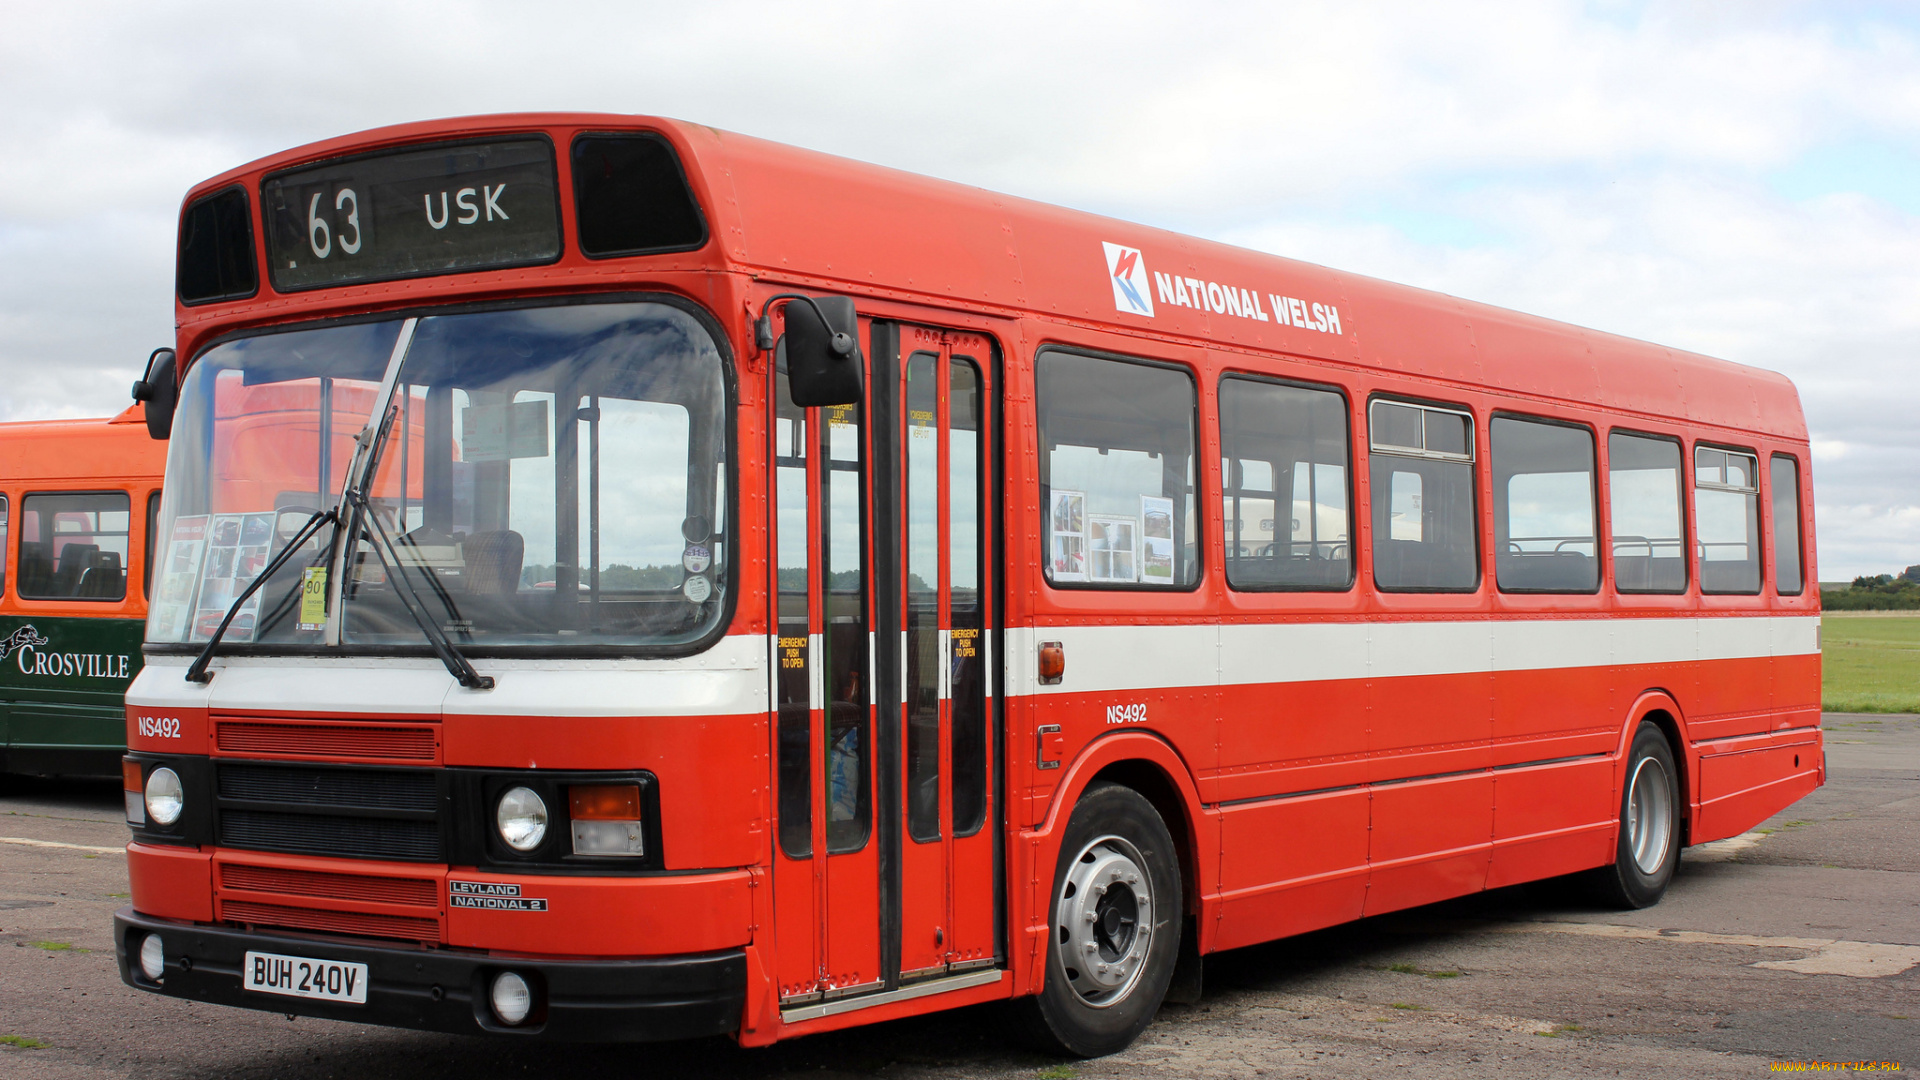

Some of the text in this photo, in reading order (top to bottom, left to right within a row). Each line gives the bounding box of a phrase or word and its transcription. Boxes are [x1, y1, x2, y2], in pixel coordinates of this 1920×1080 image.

[424, 184, 510, 229] USK
[308, 188, 361, 258] 63
[1154, 271, 1342, 335] NATIONAL WELSH
[951, 629, 979, 639] EMERGENCY
[778, 637, 808, 648] EMERGENCY
[959, 639, 971, 647] PUSH
[786, 648, 800, 658] PUSH
[955, 648, 976, 657] TO OPEN
[781, 658, 804, 668] TO OPEN
[1107, 703, 1147, 724] NS492
[138, 716, 181, 738] NS492
[453, 882, 517, 895] LEYLAND
[455, 896, 541, 910] NATIONAL 2
[253, 956, 357, 996] BUH 240V
